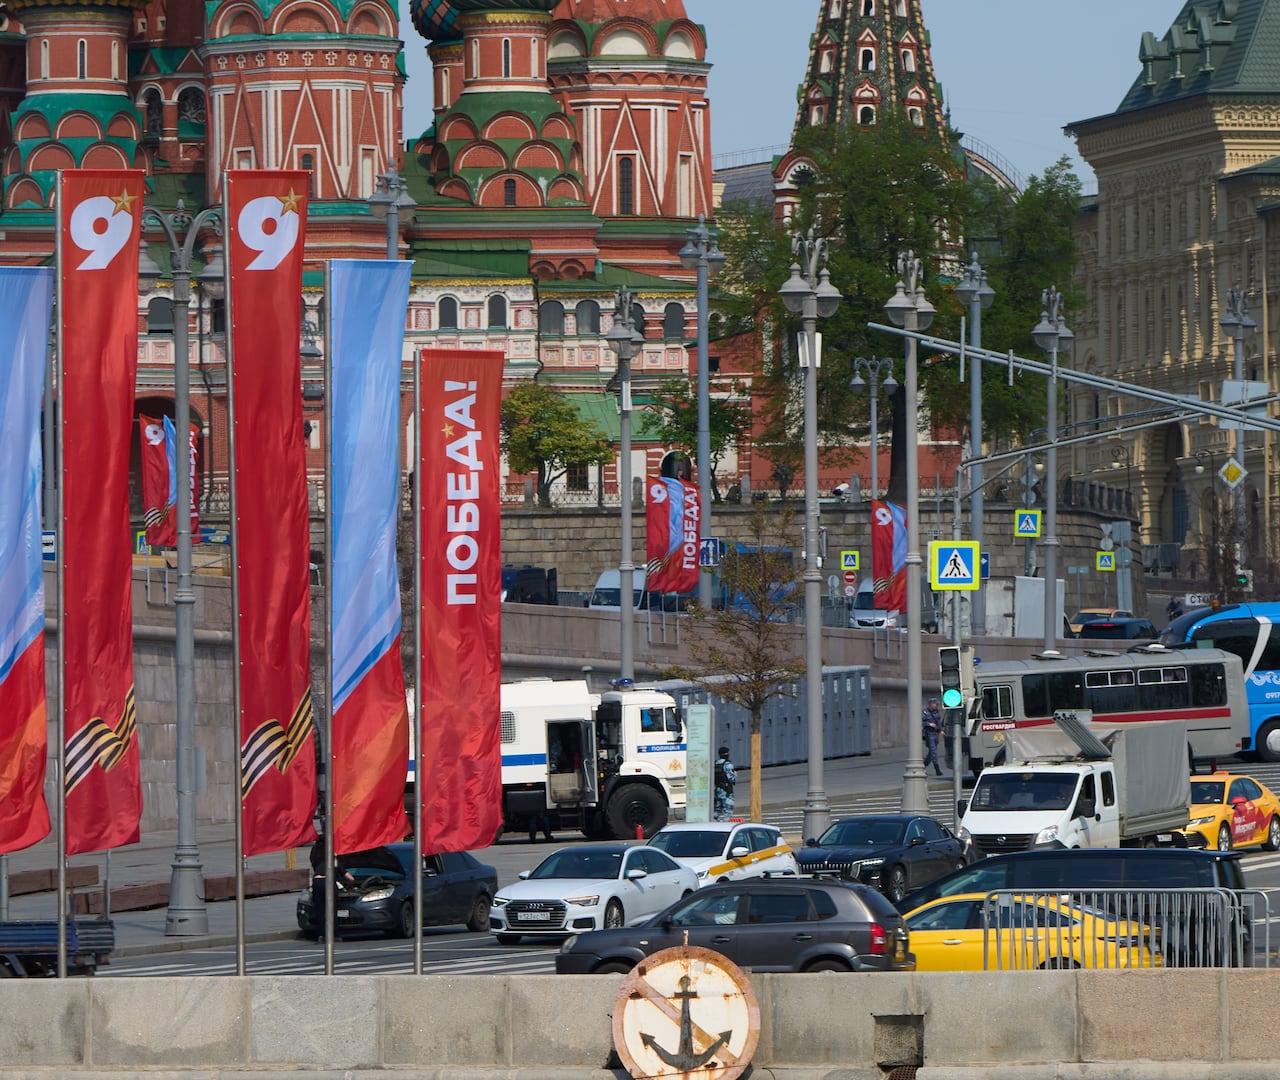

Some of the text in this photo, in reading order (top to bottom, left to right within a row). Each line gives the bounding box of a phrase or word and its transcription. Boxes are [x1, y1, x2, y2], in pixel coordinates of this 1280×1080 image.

[70, 196, 133, 270] 9
[238, 196, 299, 270] 9
[145, 424, 165, 445] 9
[444, 380, 484, 605] ПОБЕДА!
[650, 484, 668, 503] 9
[683, 486, 699, 570] ПОБЕДА!
[875, 508, 892, 526] 9
